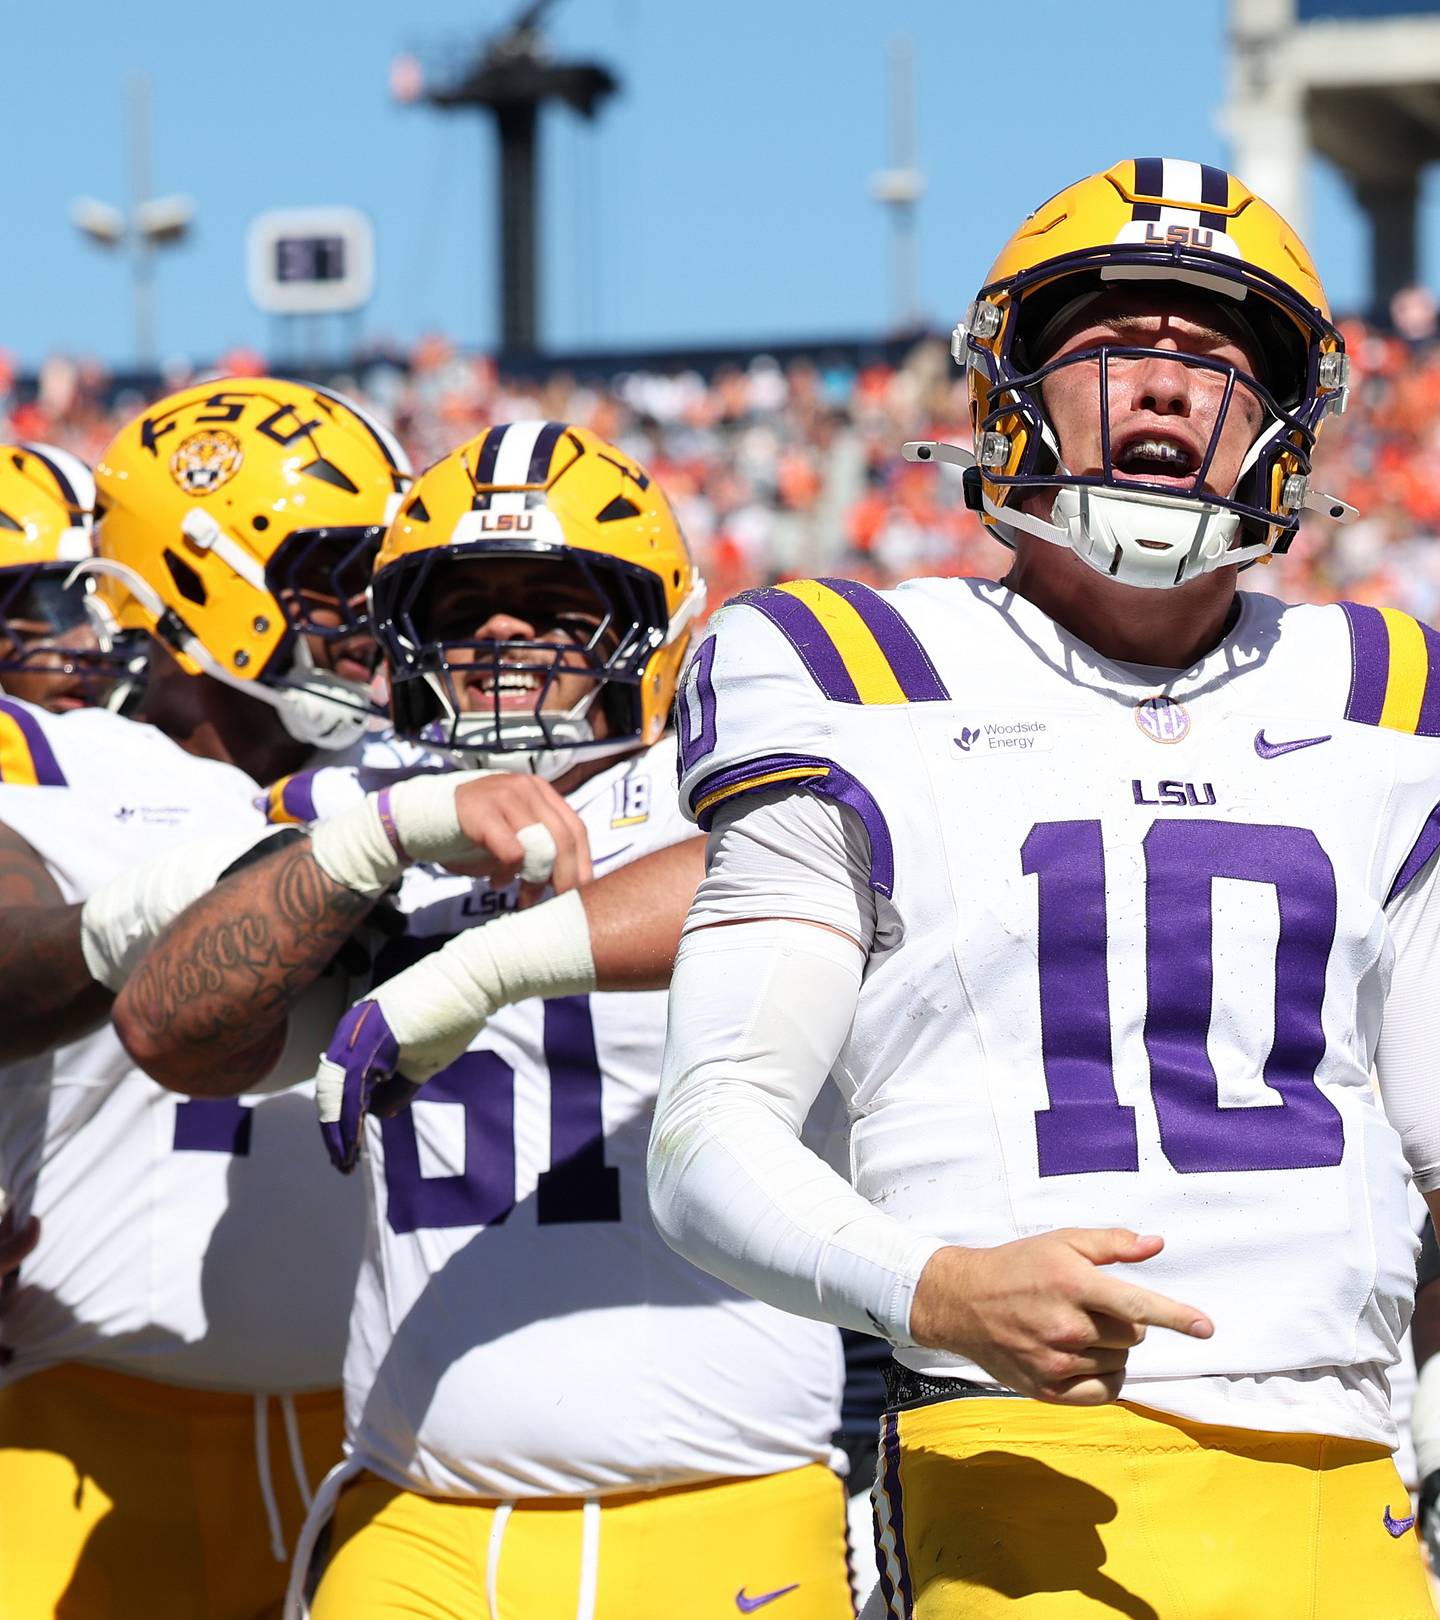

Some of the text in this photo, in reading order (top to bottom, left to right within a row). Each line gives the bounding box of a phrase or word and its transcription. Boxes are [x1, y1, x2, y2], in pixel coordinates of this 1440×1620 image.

[1145, 223, 1213, 250] LSU
[481, 514, 533, 532] LSU
[983, 721, 1047, 736] Woodside
[1139, 697, 1187, 740] SEC
[988, 736, 1035, 750] Energy
[612, 775, 651, 819] 18
[1132, 779, 1217, 807] LSU
[1020, 818, 1345, 1178] 10
